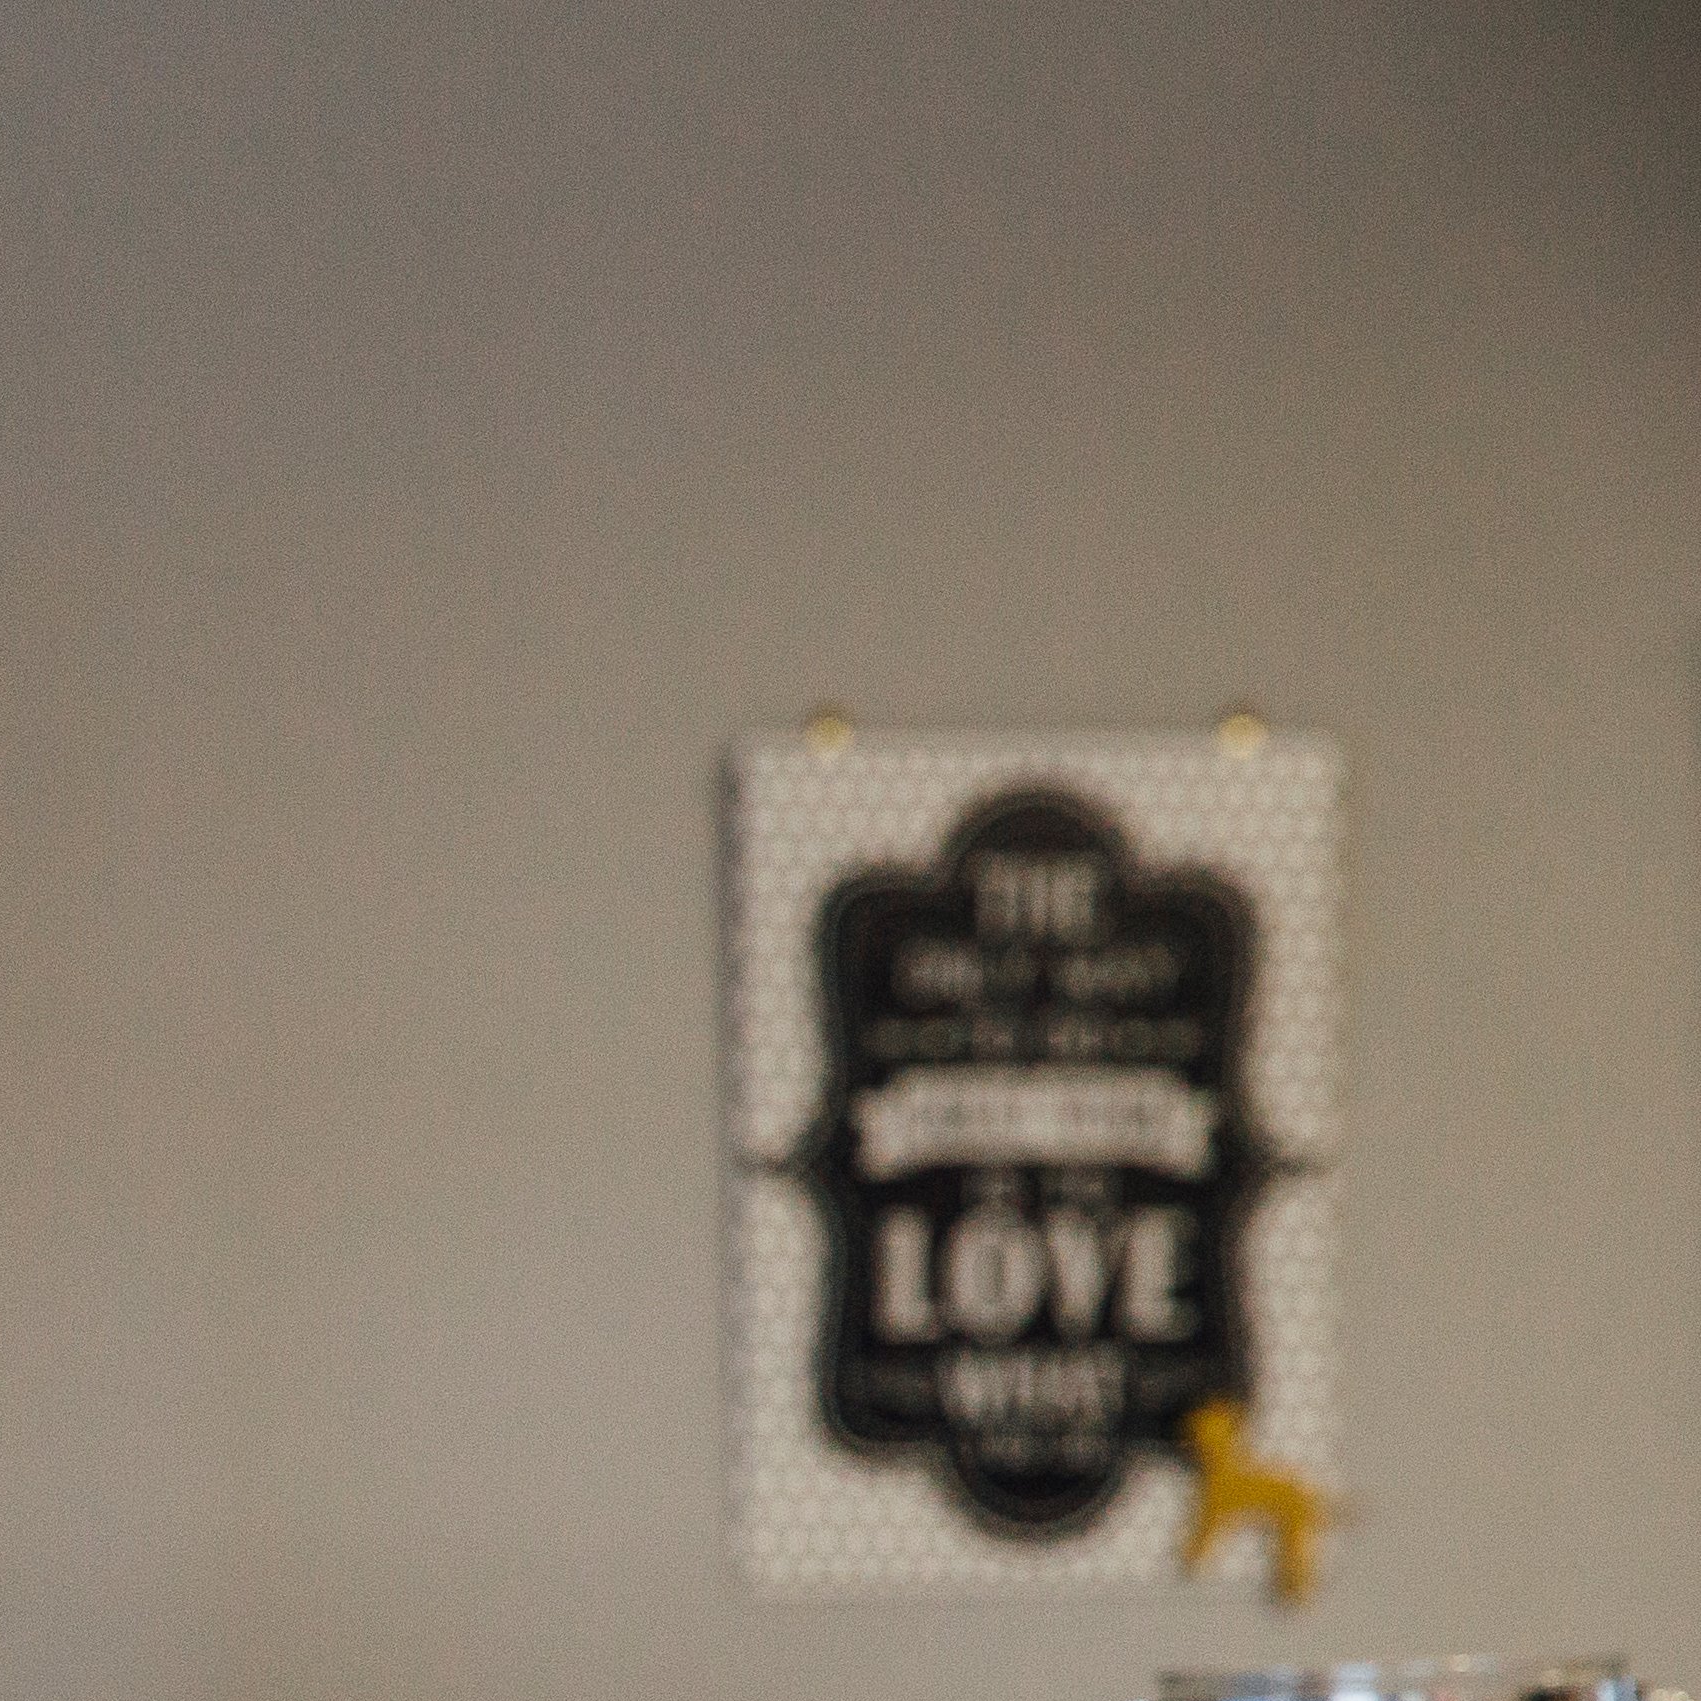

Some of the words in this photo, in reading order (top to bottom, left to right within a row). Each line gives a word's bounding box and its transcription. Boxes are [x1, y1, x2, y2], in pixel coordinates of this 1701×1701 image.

[968, 858, 1108, 941] THE
[874, 1209, 1198, 1340] LOVE
[939, 1347, 1134, 1423] WHAT
